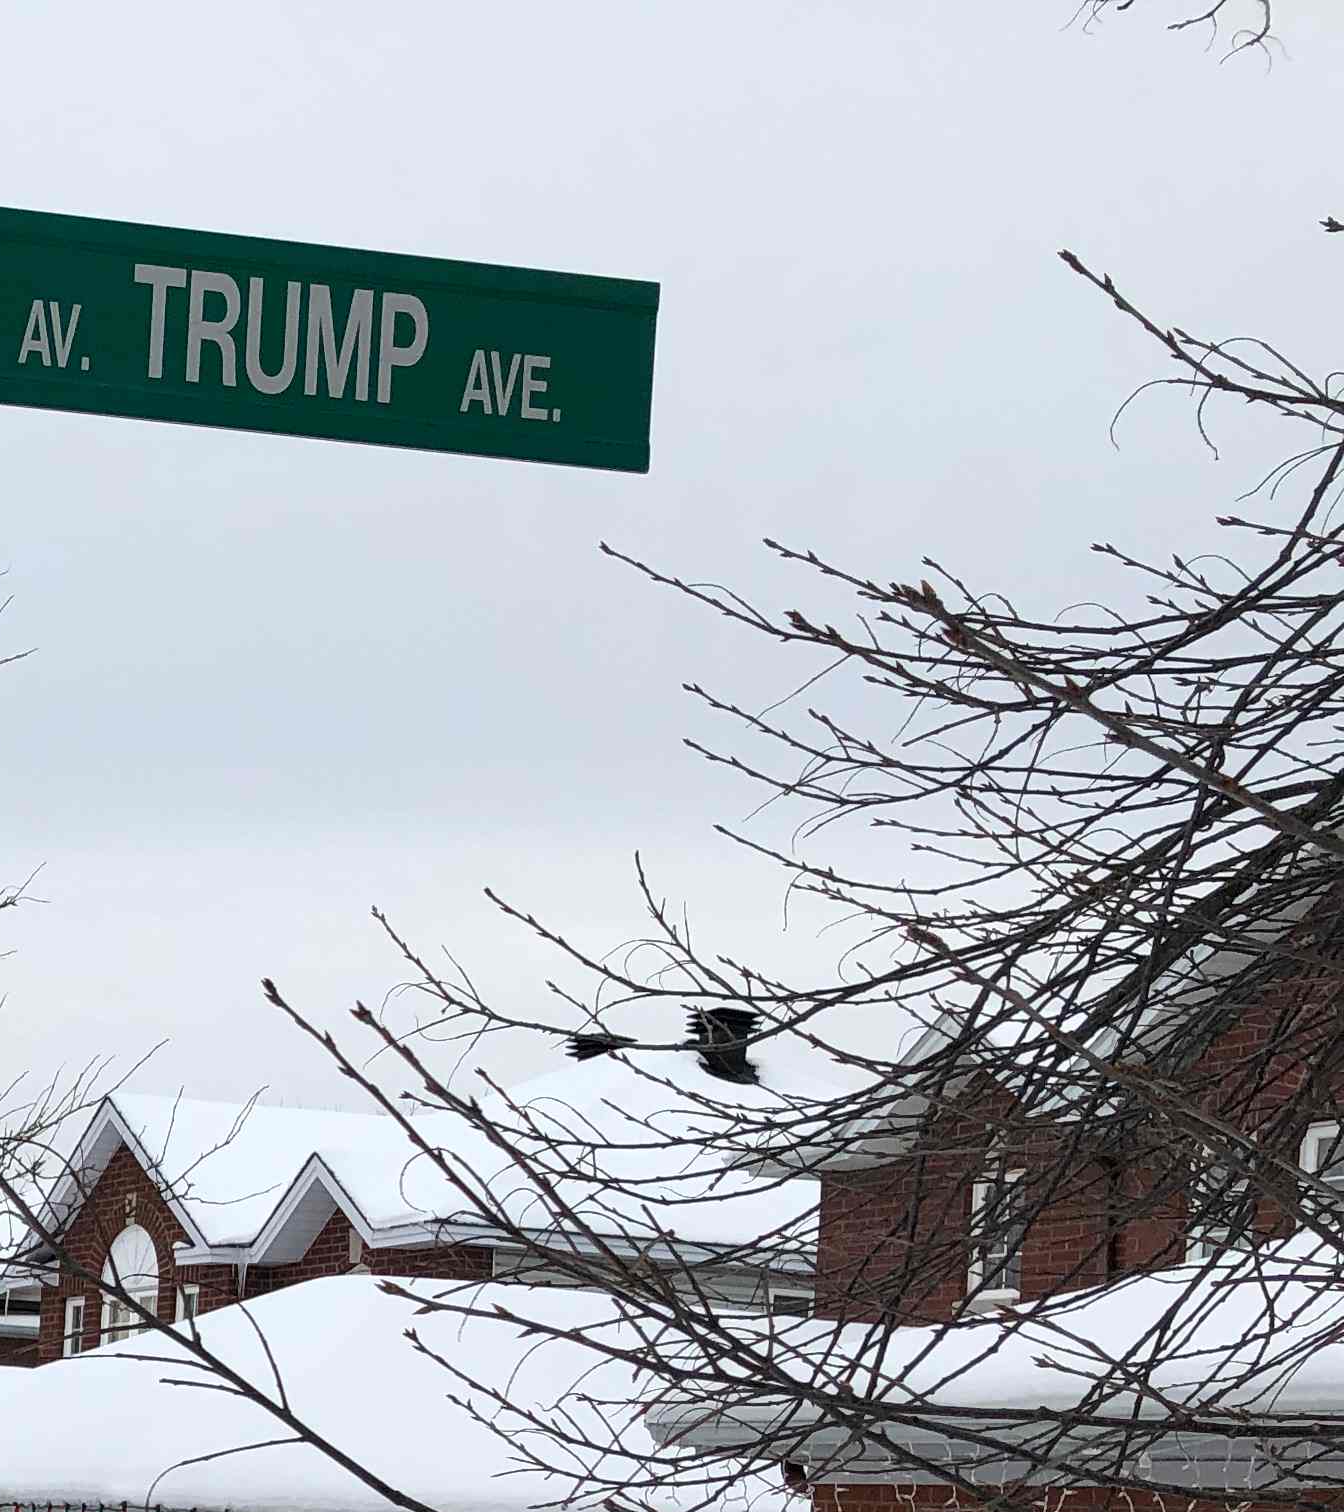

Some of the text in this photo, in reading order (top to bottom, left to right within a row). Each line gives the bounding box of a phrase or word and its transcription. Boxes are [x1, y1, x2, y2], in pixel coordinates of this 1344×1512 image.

[18, 264, 562, 422] AV. TRUMP AVE.
